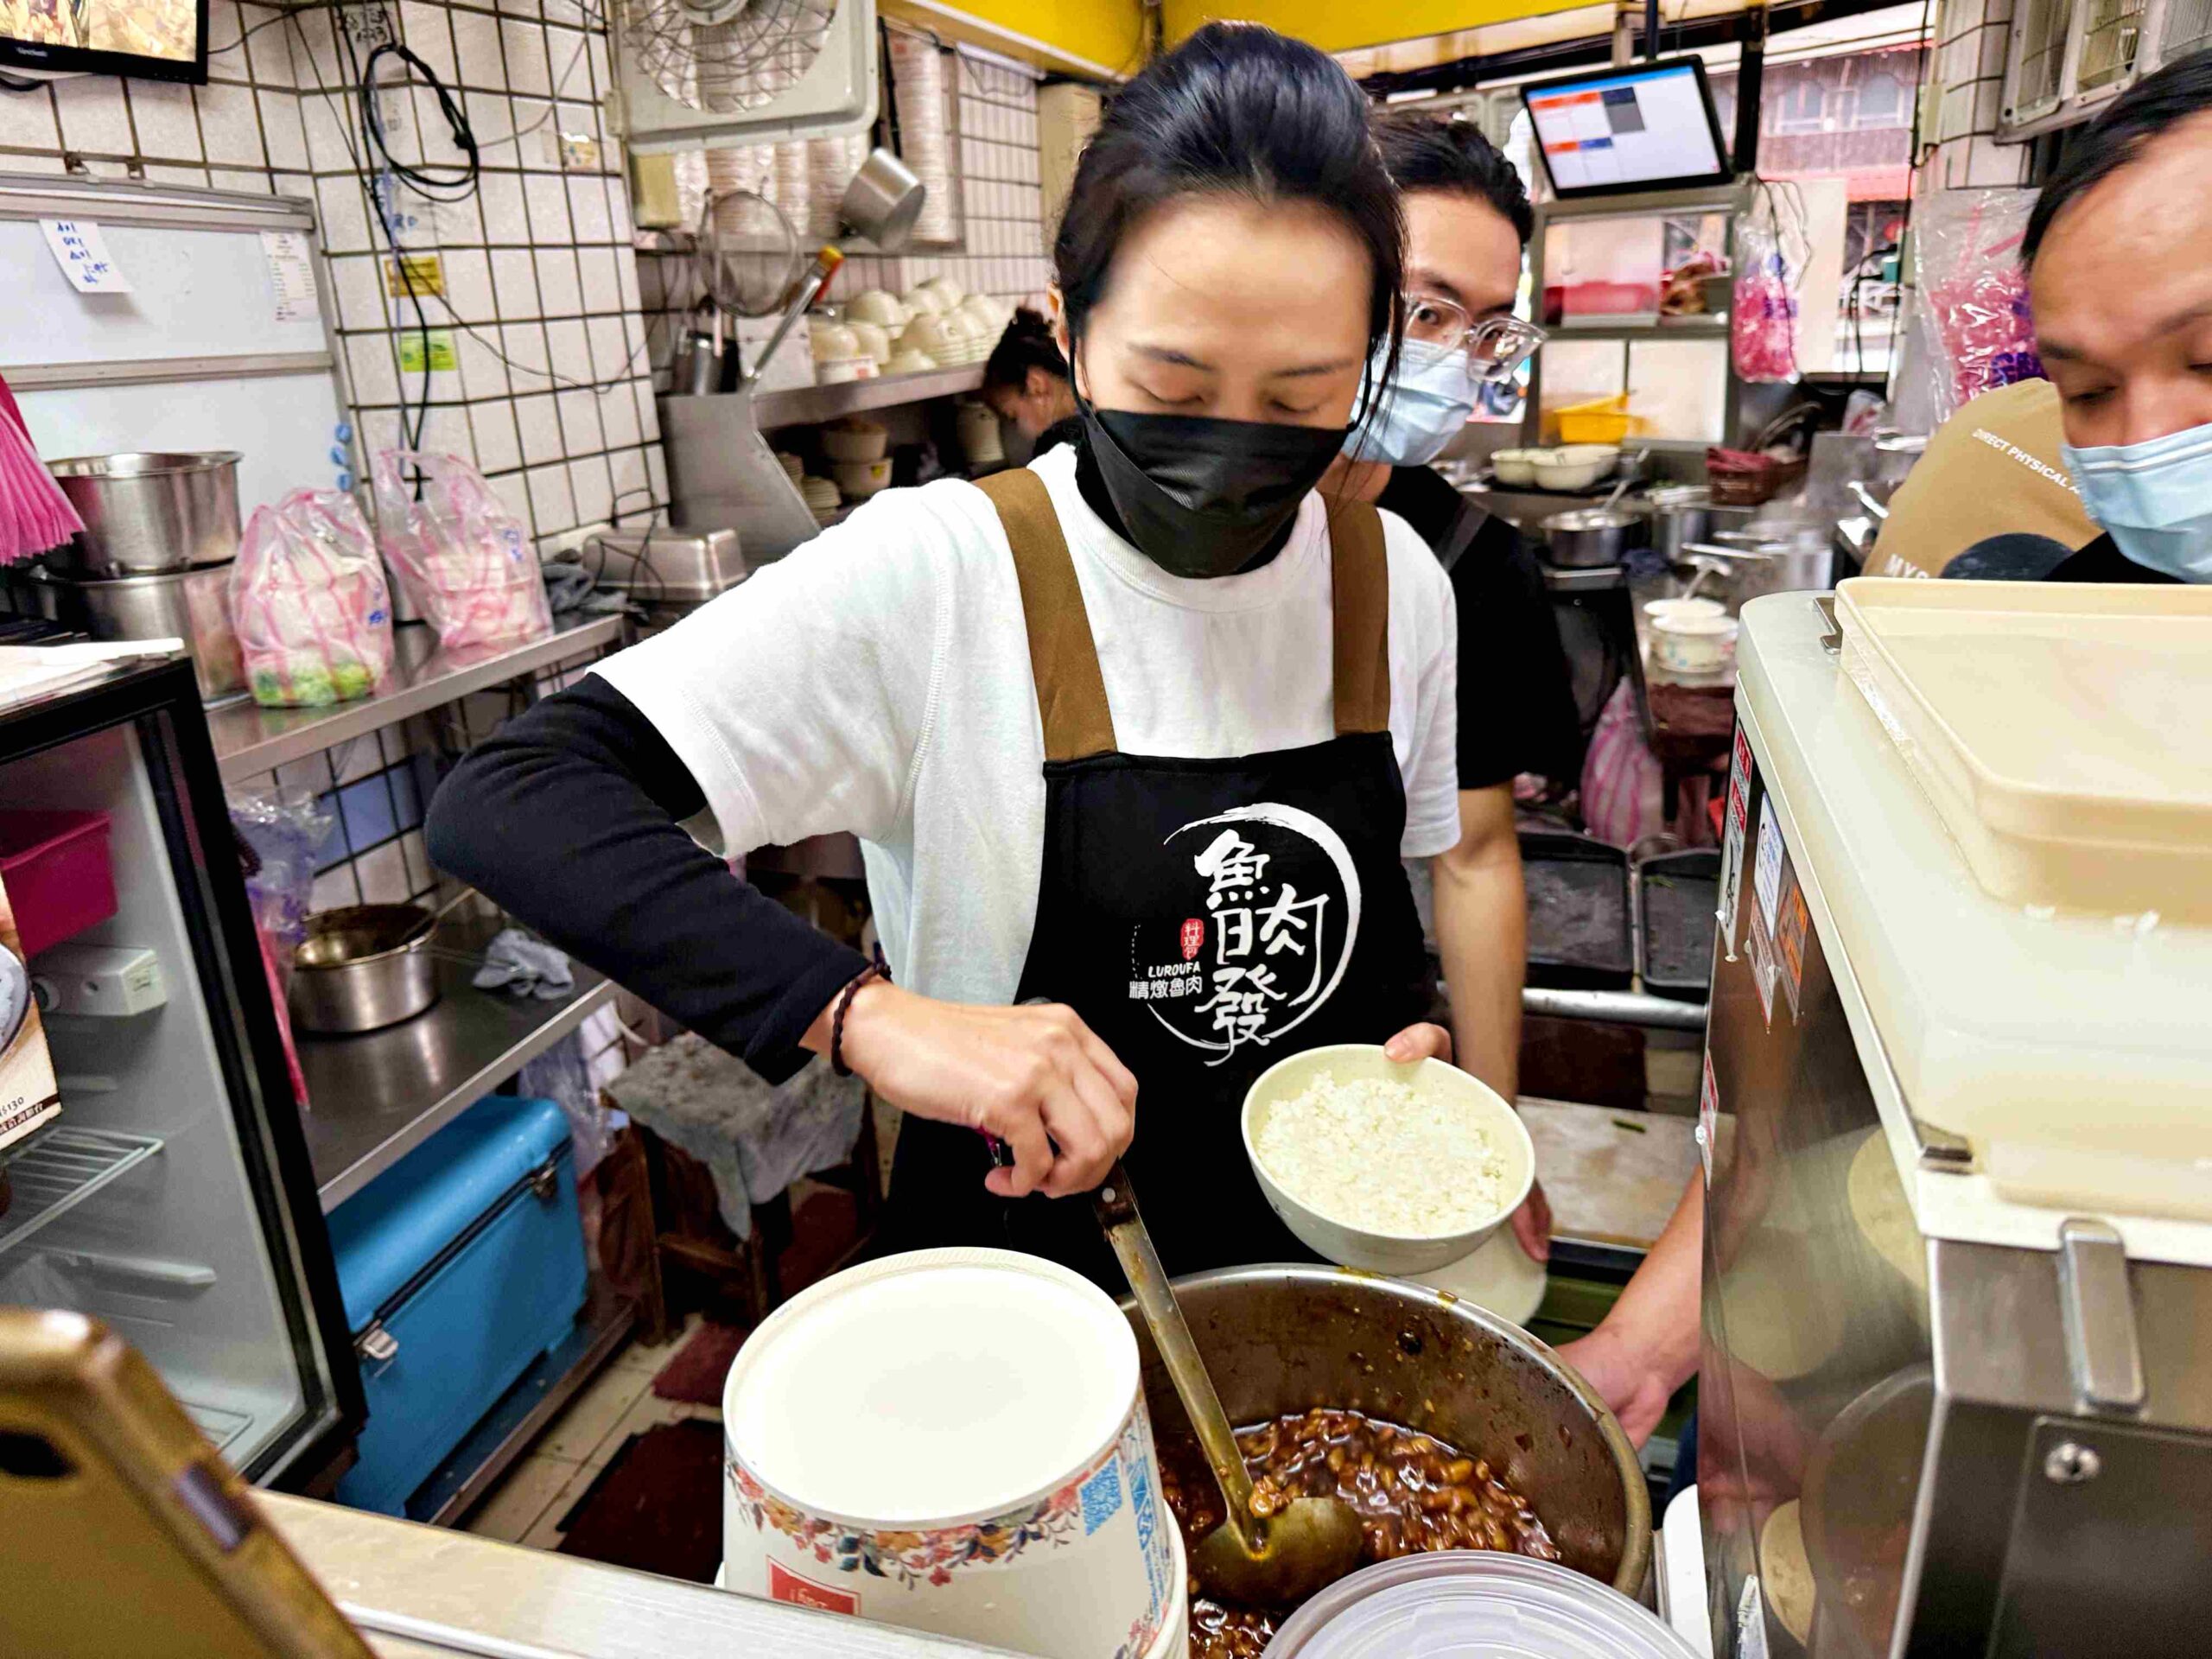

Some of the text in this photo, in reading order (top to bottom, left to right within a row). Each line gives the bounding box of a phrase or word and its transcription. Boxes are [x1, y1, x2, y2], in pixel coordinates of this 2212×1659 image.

[1972, 428, 2009, 453] DIRECT
[2007, 447, 2068, 487] PHYSICAL
[1147, 961, 1202, 978] LUROUFA
[1128, 975, 1204, 1000] 精燉魯肉
